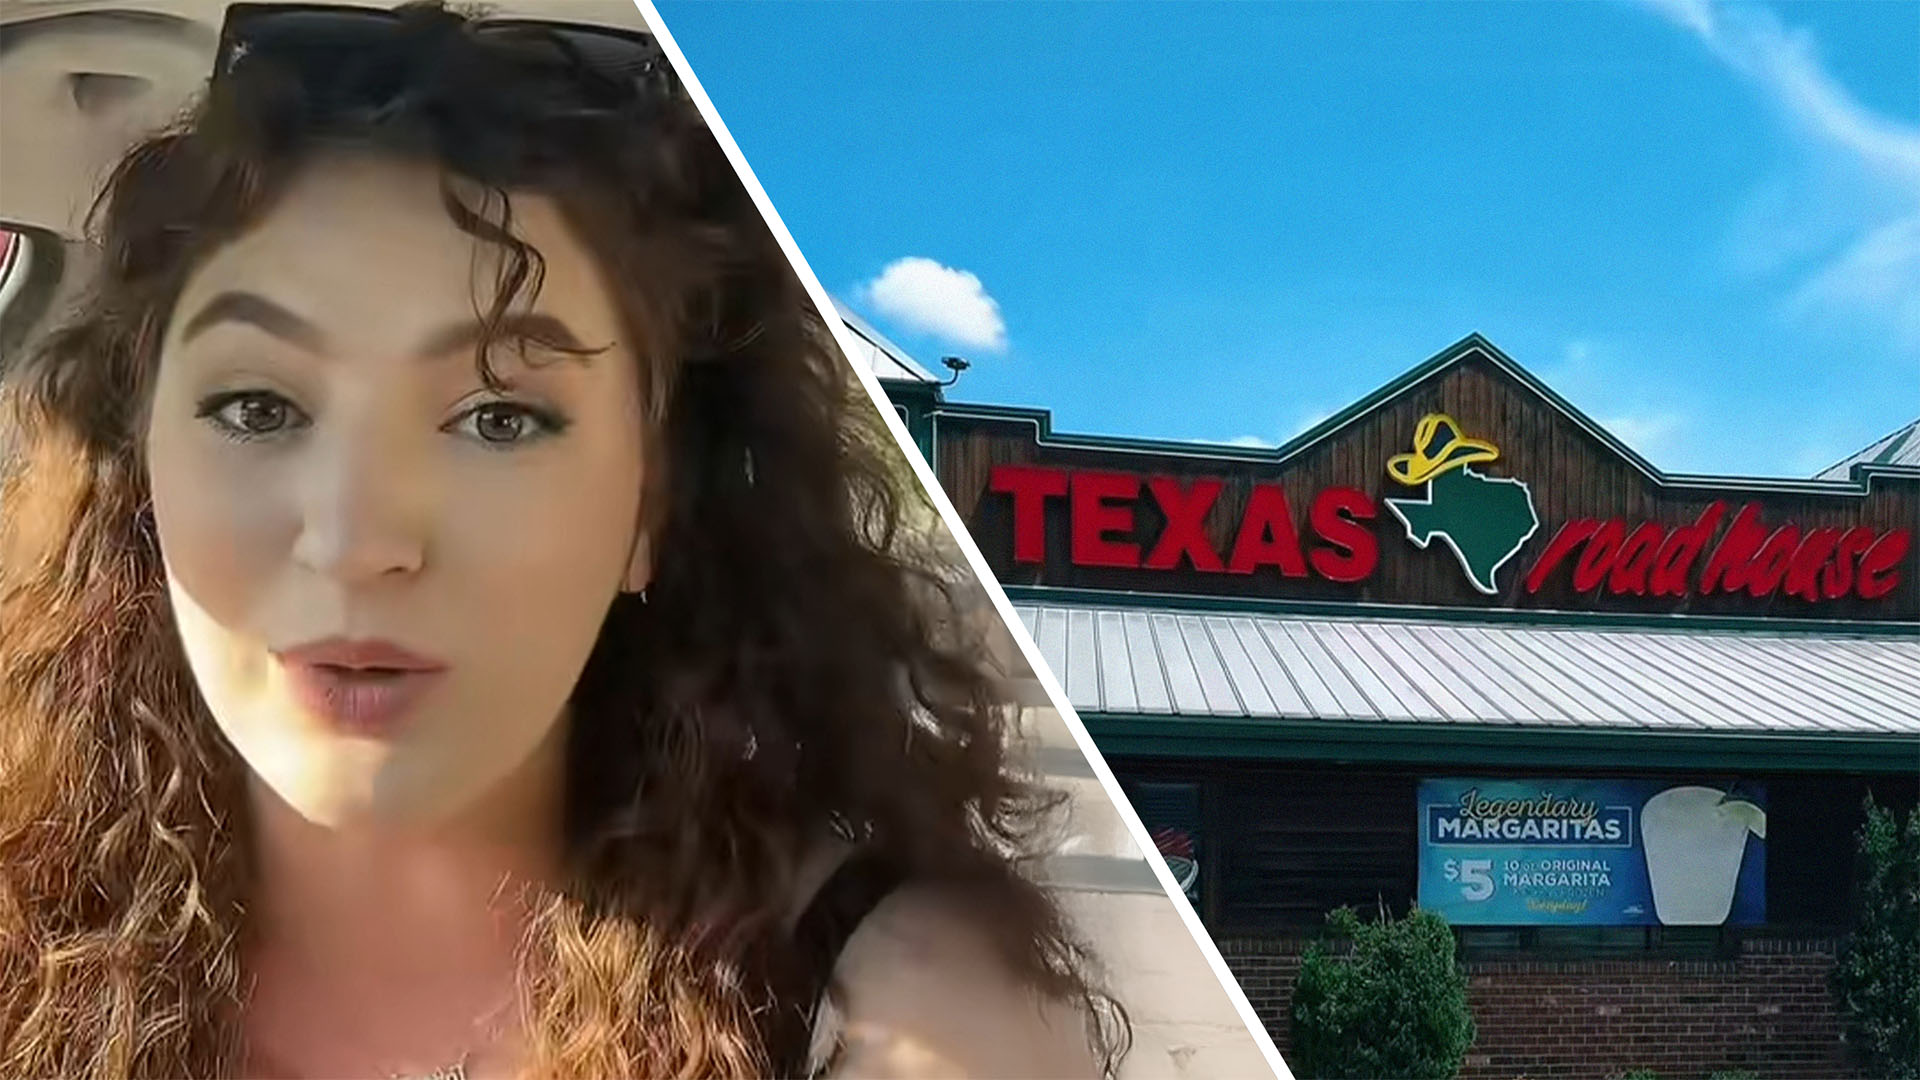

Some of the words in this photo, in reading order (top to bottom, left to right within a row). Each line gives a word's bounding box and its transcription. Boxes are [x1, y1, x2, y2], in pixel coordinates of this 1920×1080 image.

[990, 465, 1378, 583] TEXAS
[1459, 789, 1599, 828] Legendary
[1437, 817, 1622, 840] MARGARITAS
[1443, 858, 1496, 901] $5
[1504, 860, 1519, 871] 10
[1541, 859, 1611, 872] ORIGINAL
[1504, 873, 1611, 886] MARGARITA
